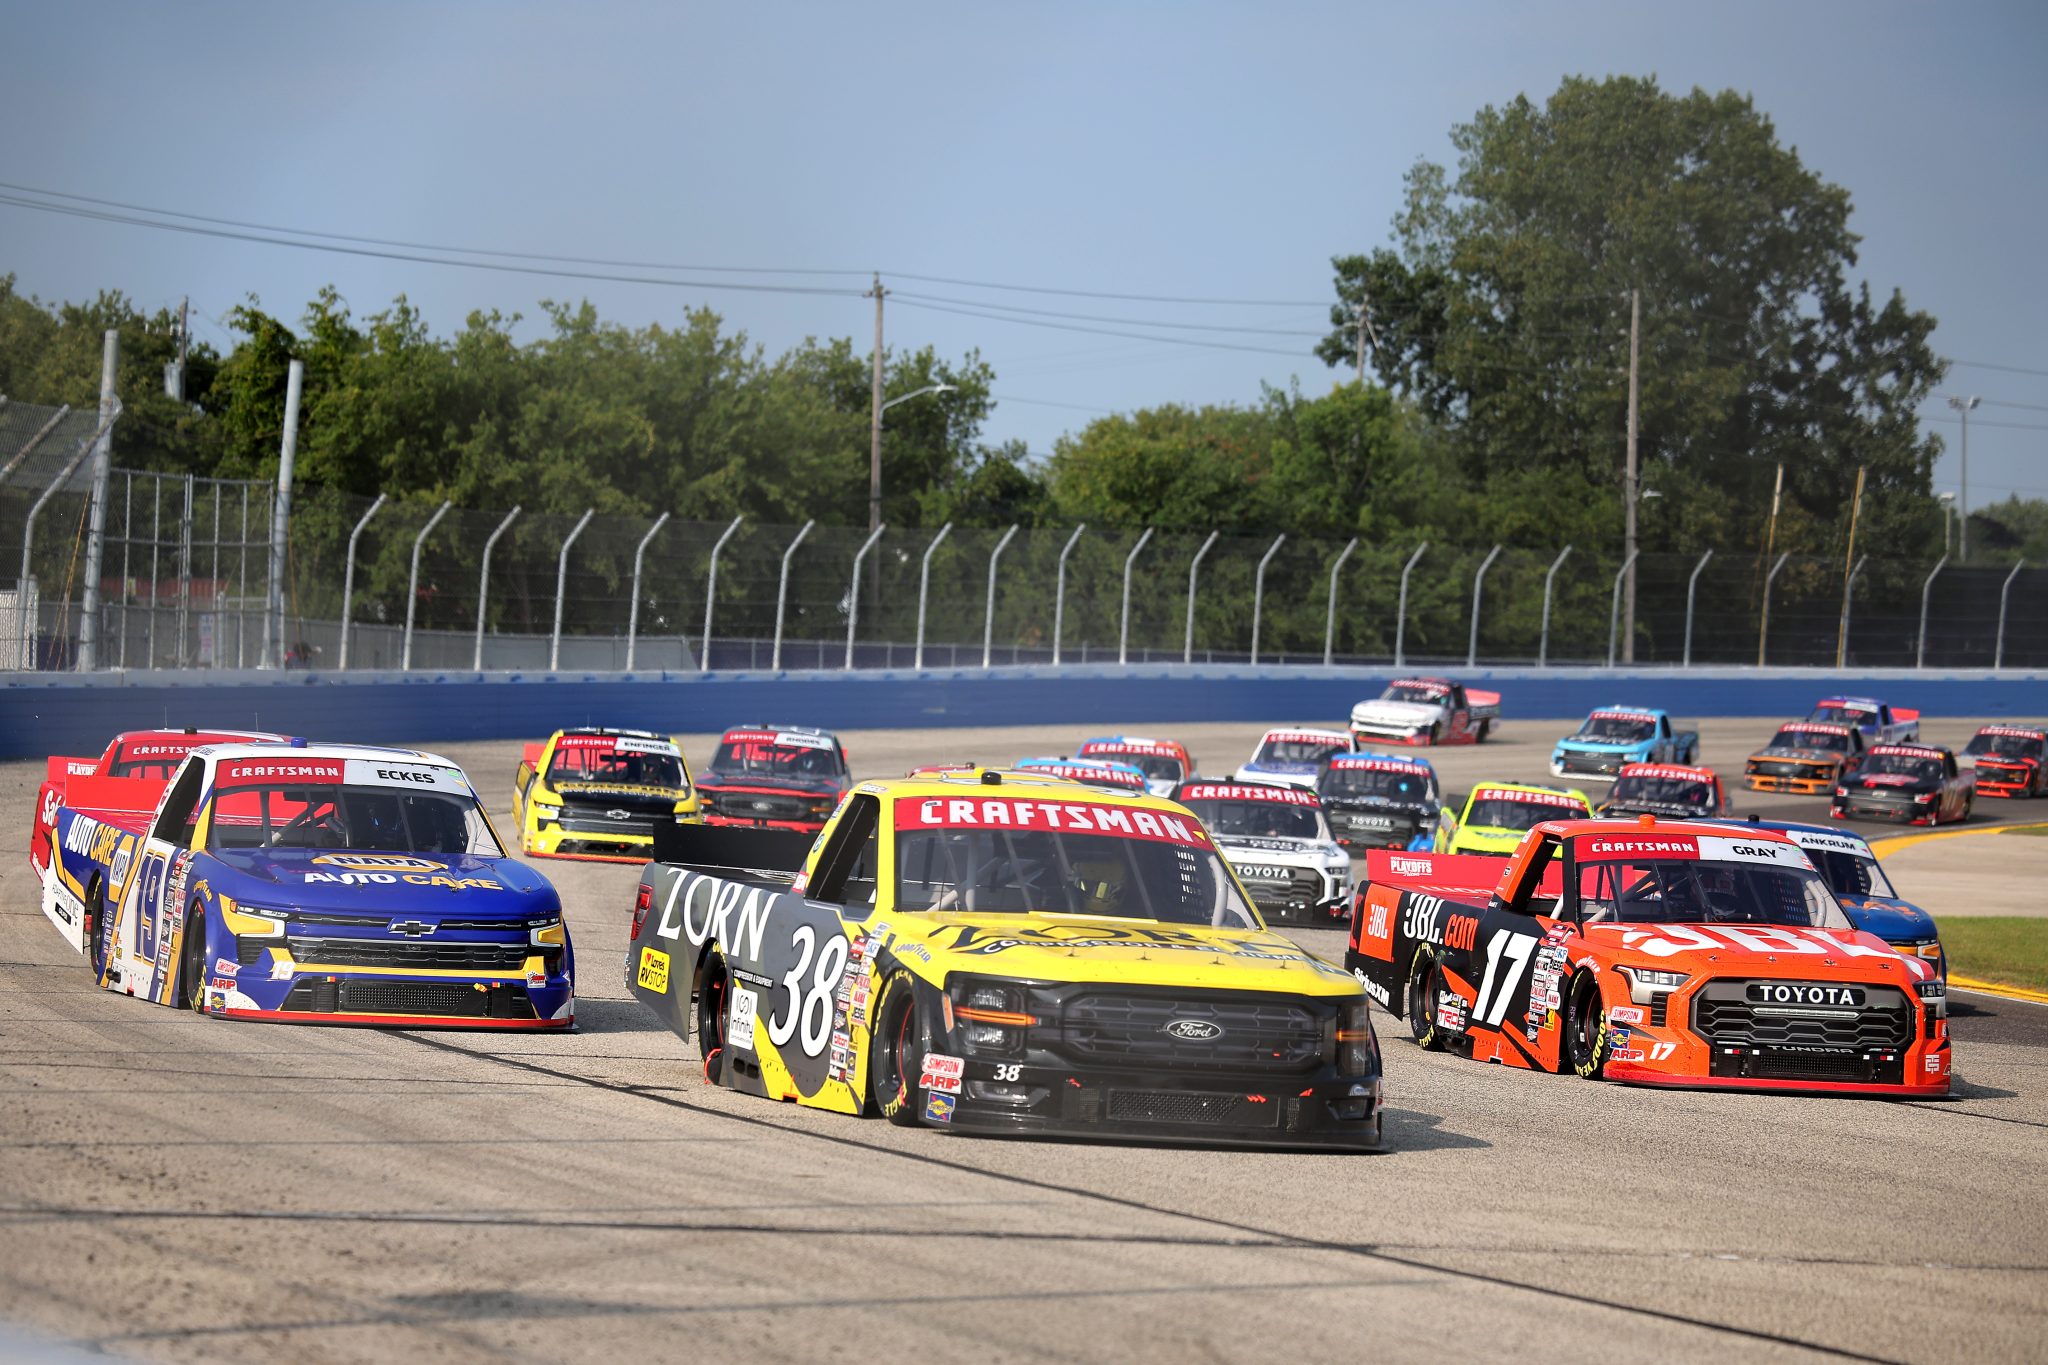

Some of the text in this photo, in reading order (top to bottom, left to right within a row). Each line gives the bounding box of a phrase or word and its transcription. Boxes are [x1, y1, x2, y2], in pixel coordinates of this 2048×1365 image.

[1089, 744, 1176, 757] CRAFTSMAN
[231, 766, 339, 778] CRAFTSMAN
[1337, 760, 1424, 775] CRAFTSMAN
[1627, 768, 1706, 782] CRAFTSMAN
[377, 769, 436, 784] ECKES
[1191, 786, 1310, 804] CRAFTSMAN
[1483, 790, 1580, 808] CRAFTSMAN
[920, 800, 1194, 842] CRAFTSMAN
[65, 813, 98, 857] AUTO
[1801, 837, 1856, 850] ANKRUM
[90, 823, 122, 866] CARE
[1591, 842, 1695, 852] CRAFTSMAN
[1733, 845, 1778, 859] GRAY
[335, 856, 430, 868] NAPA
[1391, 860, 1432, 873] PLAYOFFS
[1235, 865, 1290, 879] TOYOTA
[304, 873, 504, 890] AUTO CARE
[134, 849, 167, 968] 19
[657, 867, 783, 962] ZORN
[1368, 904, 1389, 939] JBL
[896, 943, 931, 963] GOODYEAR
[272, 961, 294, 980] 19
[651, 955, 665, 971] Love's
[212, 979, 236, 990] ARP
[1472, 928, 1539, 1027] 17
[768, 925, 849, 1057] 38
[1354, 967, 1390, 1007] SiriusXM
[1760, 986, 1855, 1005] TOYOTA
[1438, 1008, 1459, 1027] TRD
[1613, 1008, 1640, 1020] SIMPSON
[1176, 1023, 1212, 1038] Ford
[1612, 1049, 1643, 1059] ARP
[1650, 1043, 1677, 1060] 17
[1769, 1045, 1854, 1054] TUNDRA
[927, 1058, 960, 1073] SIMPSON
[993, 1064, 1023, 1081] 38
[920, 1073, 961, 1090] ARP
